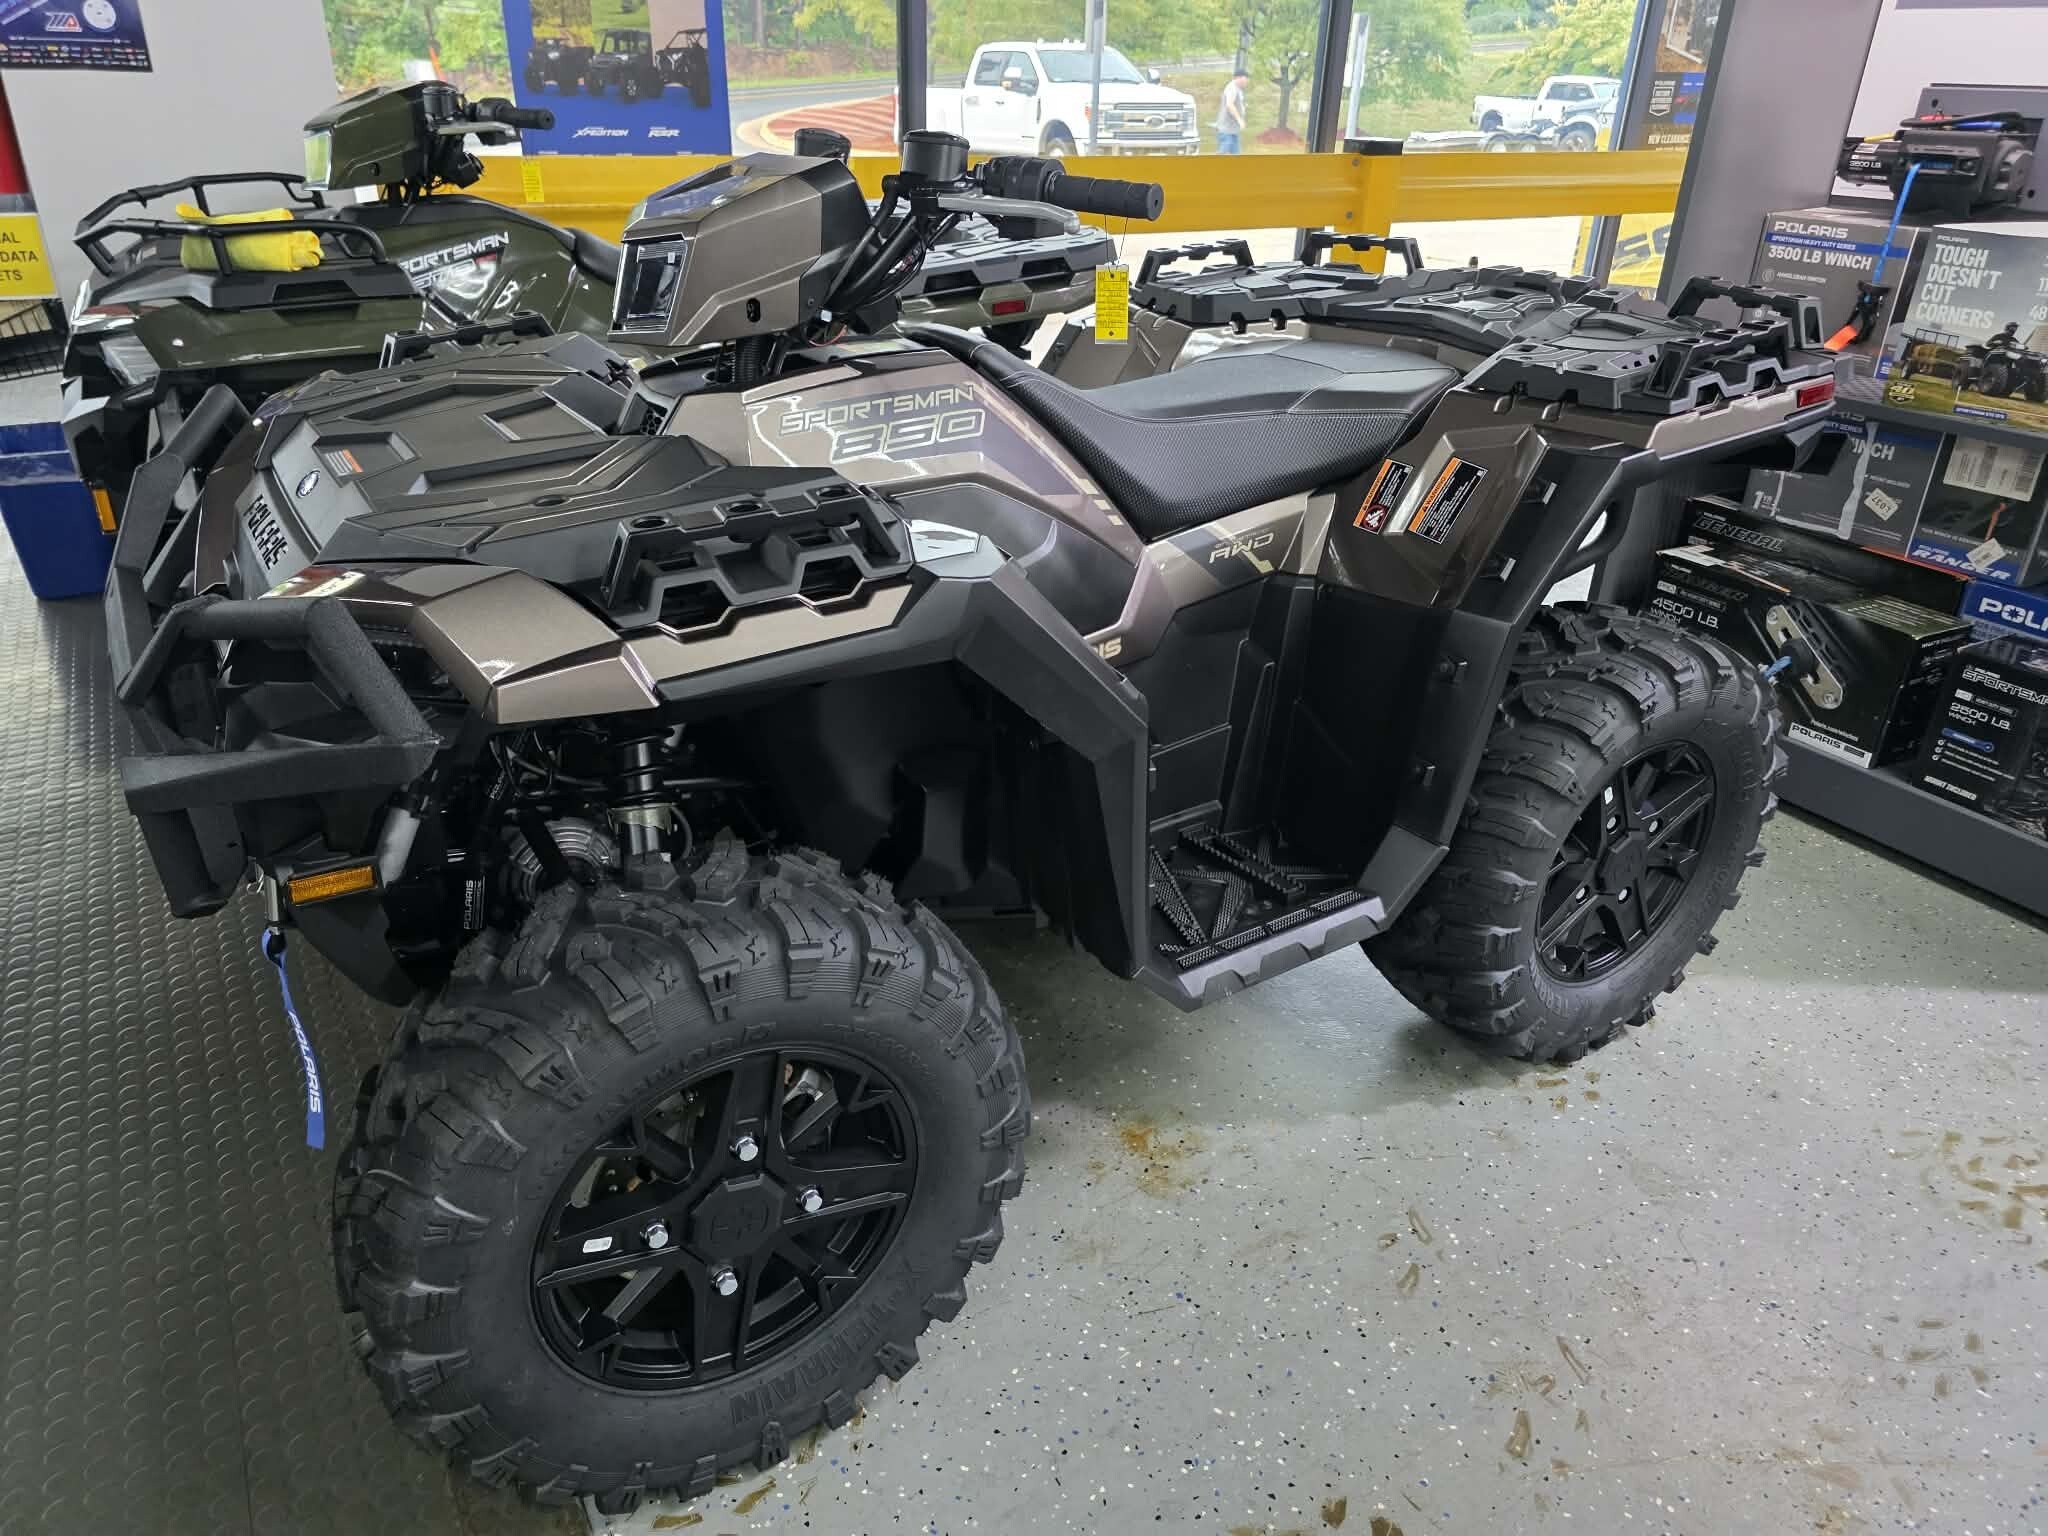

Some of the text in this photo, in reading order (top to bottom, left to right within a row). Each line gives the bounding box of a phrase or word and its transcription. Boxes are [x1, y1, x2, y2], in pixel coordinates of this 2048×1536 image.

[0, 231, 21, 244] AL
[1773, 221, 1849, 239] POLARIS
[0, 250, 39, 262] DATA
[399, 231, 510, 273] PORTSMAN
[1803, 239, 1822, 247] HEAVY
[1837, 243, 1856, 251] SERIES
[1934, 244, 1989, 268] TOUGH
[1768, 245, 1873, 271] 3500 LB WINCH
[1926, 263, 2003, 290] DOESN'T
[1920, 283, 1957, 304] CUT
[1915, 302, 1995, 329] CORNERS
[779, 384, 976, 437] SPORTSMAN
[829, 408, 986, 464] 850
[1694, 517, 1785, 552] GENERAL
[1209, 532, 1275, 564] AWD
[1650, 607, 1681, 624] WINCH
[1652, 597, 1695, 620] 4500
[1948, 711, 1977, 726] WINCH
[1950, 702, 1988, 723] 2500
[1791, 724, 1841, 749] POLARIS
[463, 879, 474, 929] POLARIS
[287, 1010, 321, 1113] POLARIS
